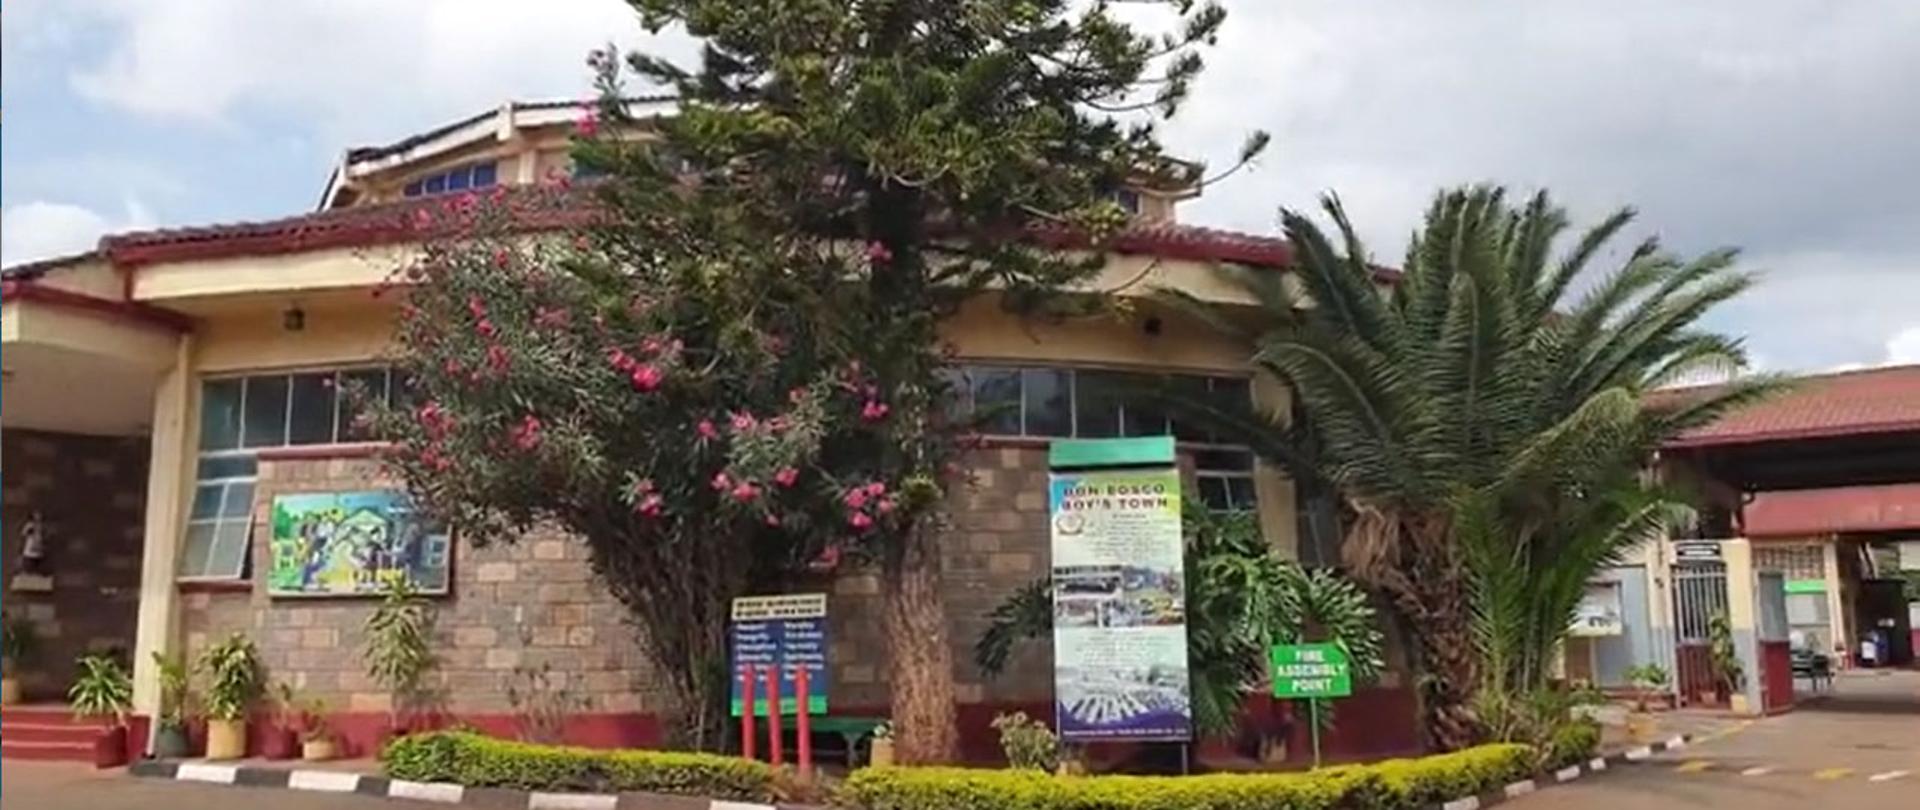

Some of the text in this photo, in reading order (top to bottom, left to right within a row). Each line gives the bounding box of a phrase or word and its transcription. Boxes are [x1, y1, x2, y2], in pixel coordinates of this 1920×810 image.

[1063, 483, 1165, 497] DON BOSCO
[1119, 498, 1168, 509] TOWN
[1295, 650, 1325, 662] FIRE
[1277, 664, 1345, 677] ASSEMBLY
[1291, 679, 1332, 692] POINT
